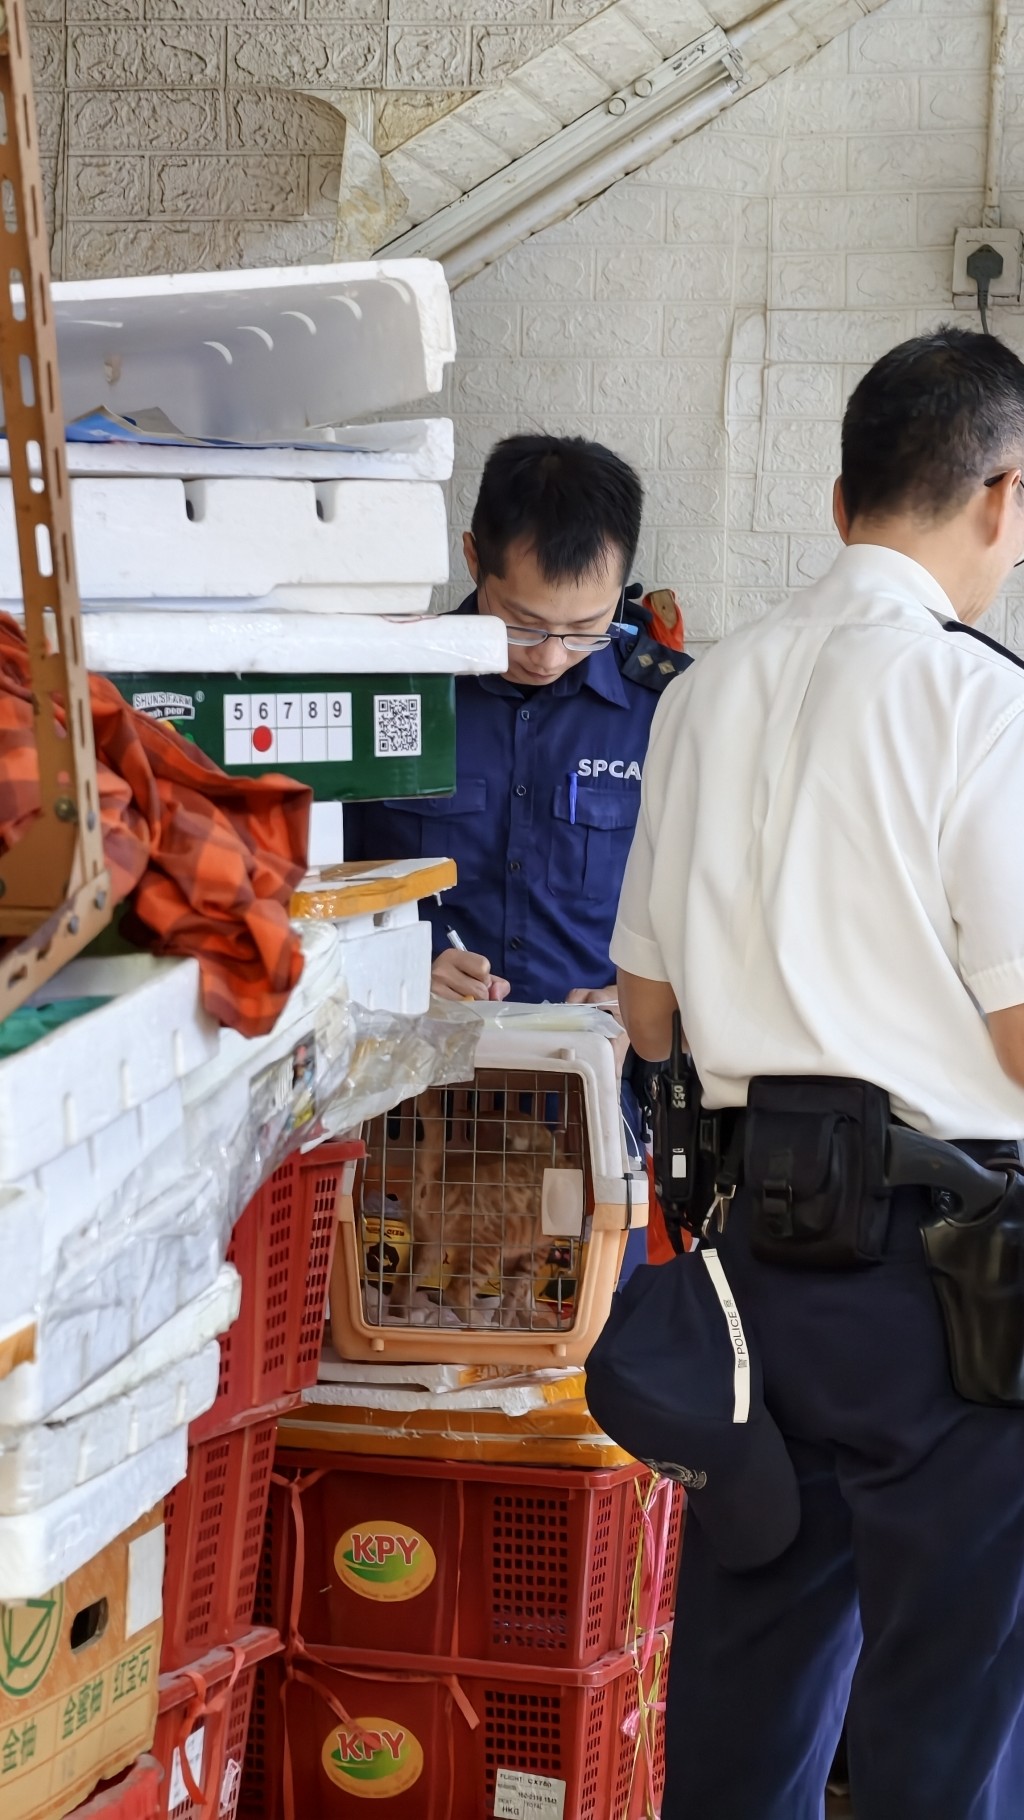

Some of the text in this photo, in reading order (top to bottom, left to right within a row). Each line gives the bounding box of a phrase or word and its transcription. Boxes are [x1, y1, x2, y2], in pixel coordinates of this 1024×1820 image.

[233, 700, 343, 721] 5 6 7 8 9
[578, 759, 641, 780] SPCA
[728, 1311, 745, 1355] POLICE
[352, 1533, 420, 1565] KPY
